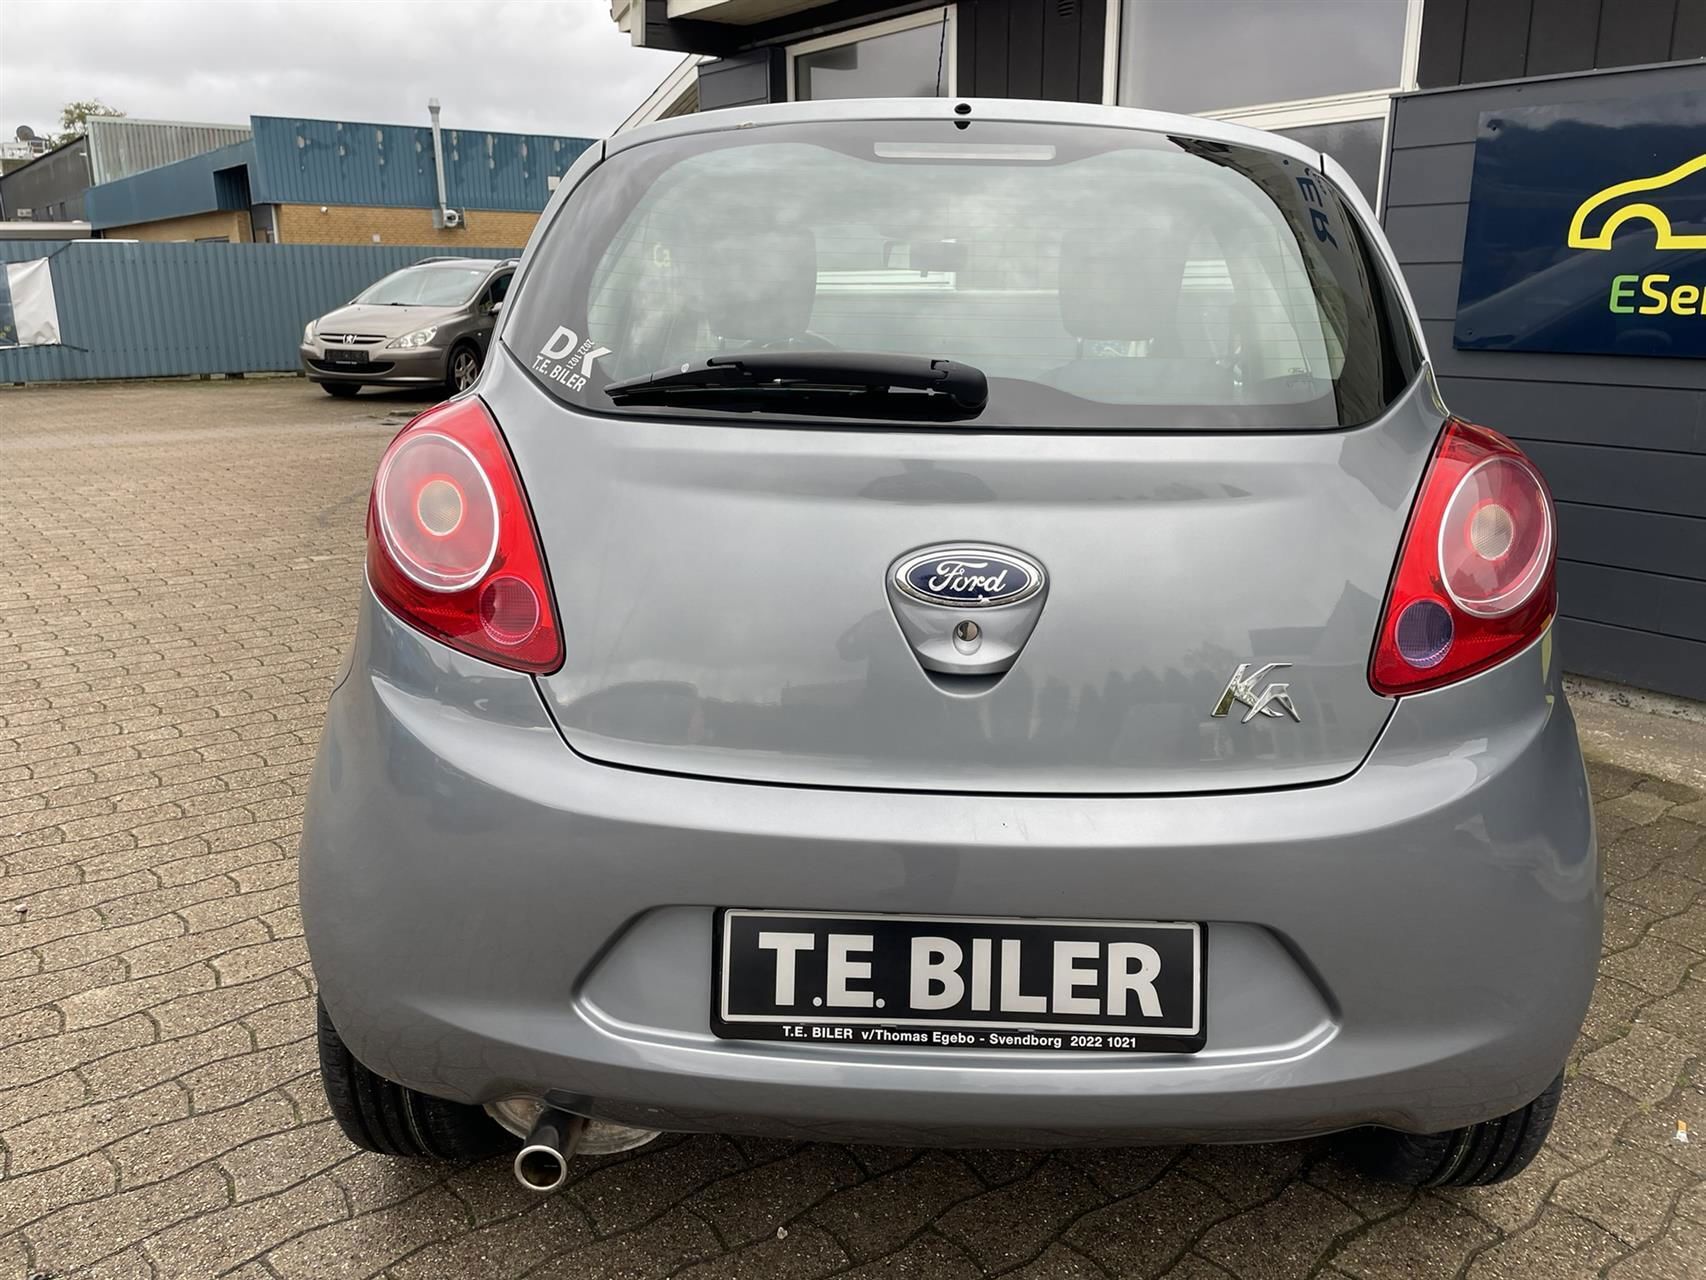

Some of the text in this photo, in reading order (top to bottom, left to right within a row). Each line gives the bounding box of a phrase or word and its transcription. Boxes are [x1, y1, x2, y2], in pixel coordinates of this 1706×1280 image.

[531, 355, 587, 392] T.E. BILER
[540, 325, 612, 378] DK
[928, 560, 1008, 592] Ford
[1211, 662, 1301, 723] Ka
[758, 931, 1164, 1018] T.E. BILER
[782, 1025, 808, 1038] T.E.
[812, 1026, 853, 1040] BILER
[861, 1029, 928, 1043] v/Thomas
[932, 1031, 975, 1045] Egebo
[989, 1033, 1062, 1049] Svendborg
[1070, 1036, 1103, 1048] 2022
[1107, 1036, 1137, 1049] 1021
